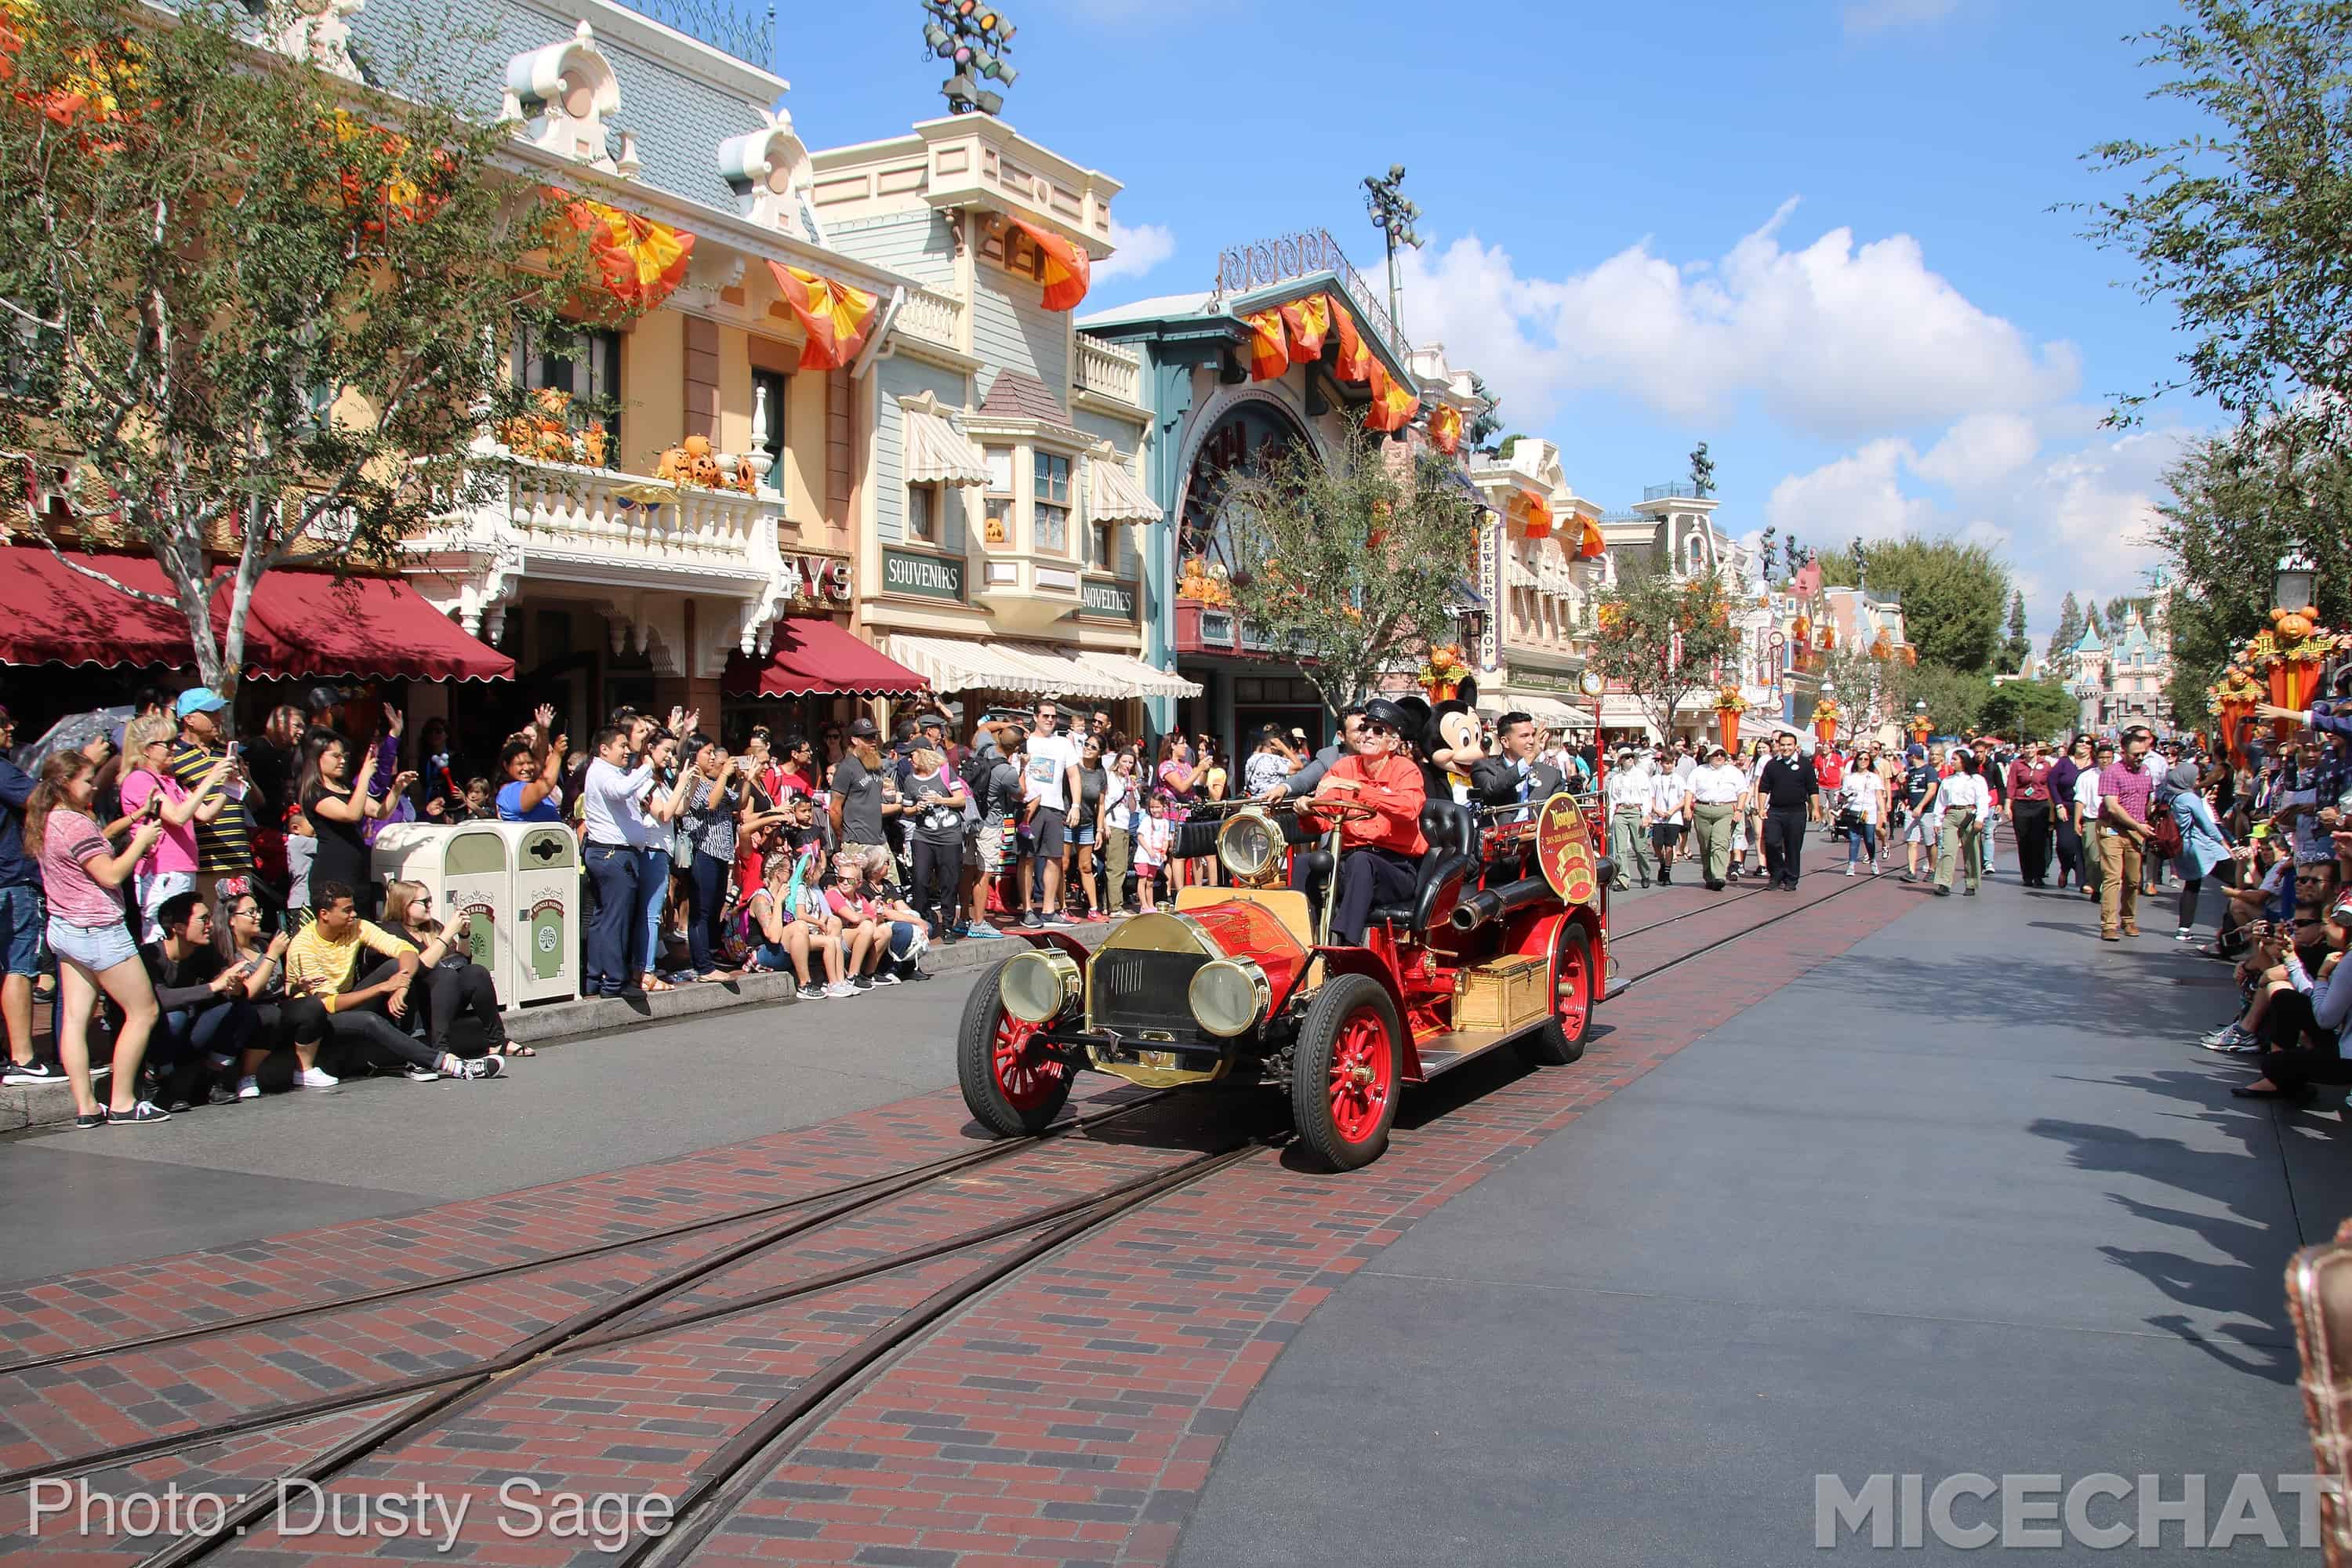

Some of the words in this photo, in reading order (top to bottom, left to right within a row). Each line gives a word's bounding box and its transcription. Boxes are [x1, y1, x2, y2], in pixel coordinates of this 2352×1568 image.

[888, 558, 958, 590] SOUVENIRS
[1083, 586, 1131, 612] NOVELTIES
[1483, 613, 1494, 657] SHOP
